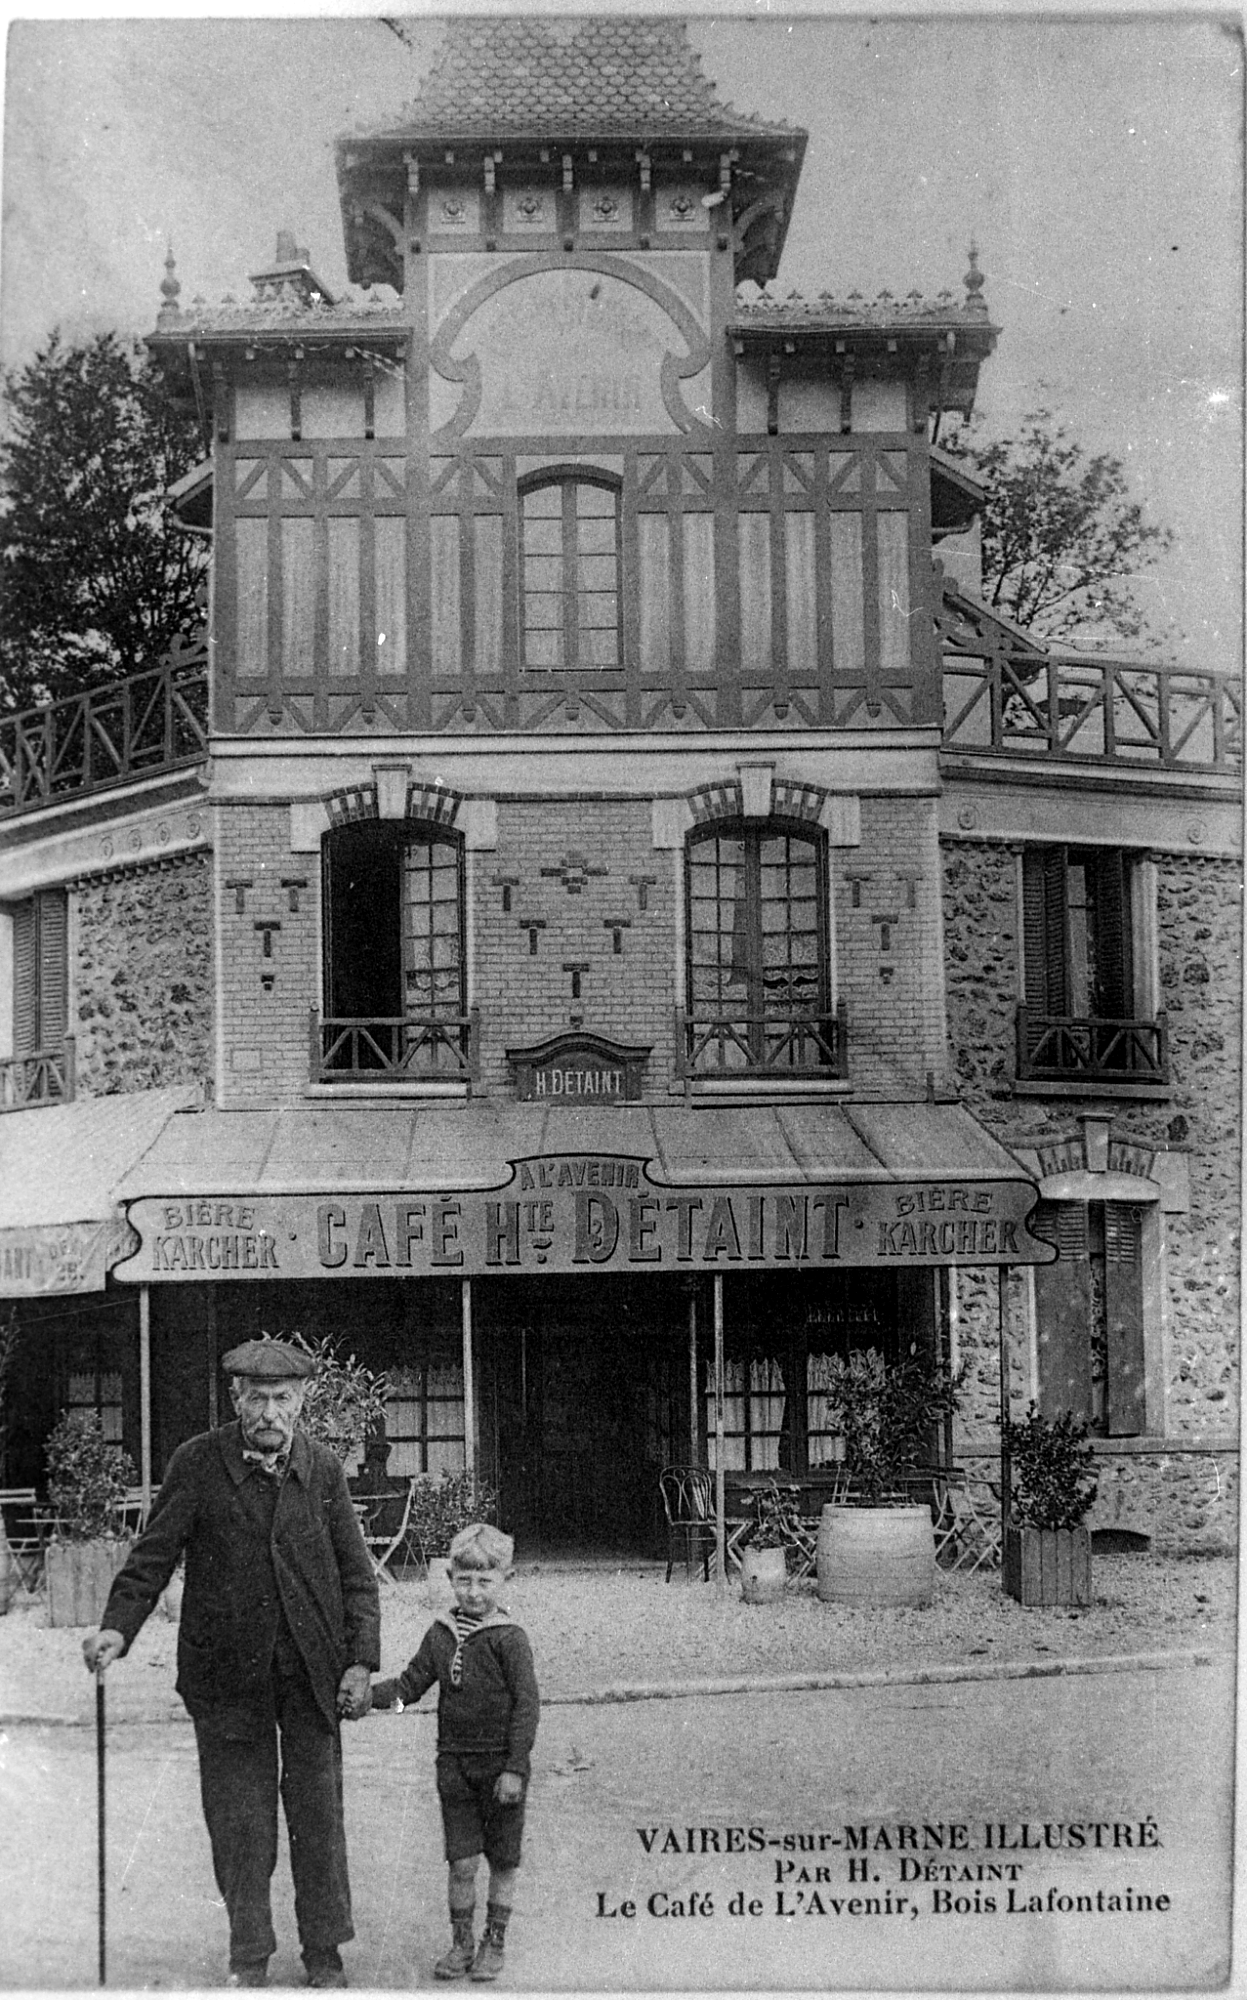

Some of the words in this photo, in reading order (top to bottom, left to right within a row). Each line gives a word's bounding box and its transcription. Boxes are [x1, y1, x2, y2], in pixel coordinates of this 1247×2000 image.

[536, 1071, 546, 1095] H
[538, 1161, 640, 1189] L'AVENIR
[163, 1200, 255, 1231] BIÈRE
[896, 1187, 993, 1218] BIÈRE
[316, 1195, 464, 1268] CAFÉ
[571, 1190, 850, 1264] DÉTAINT
[877, 1220, 1020, 1256] KARCHER
[152, 1235, 280, 1271] KARCHER
